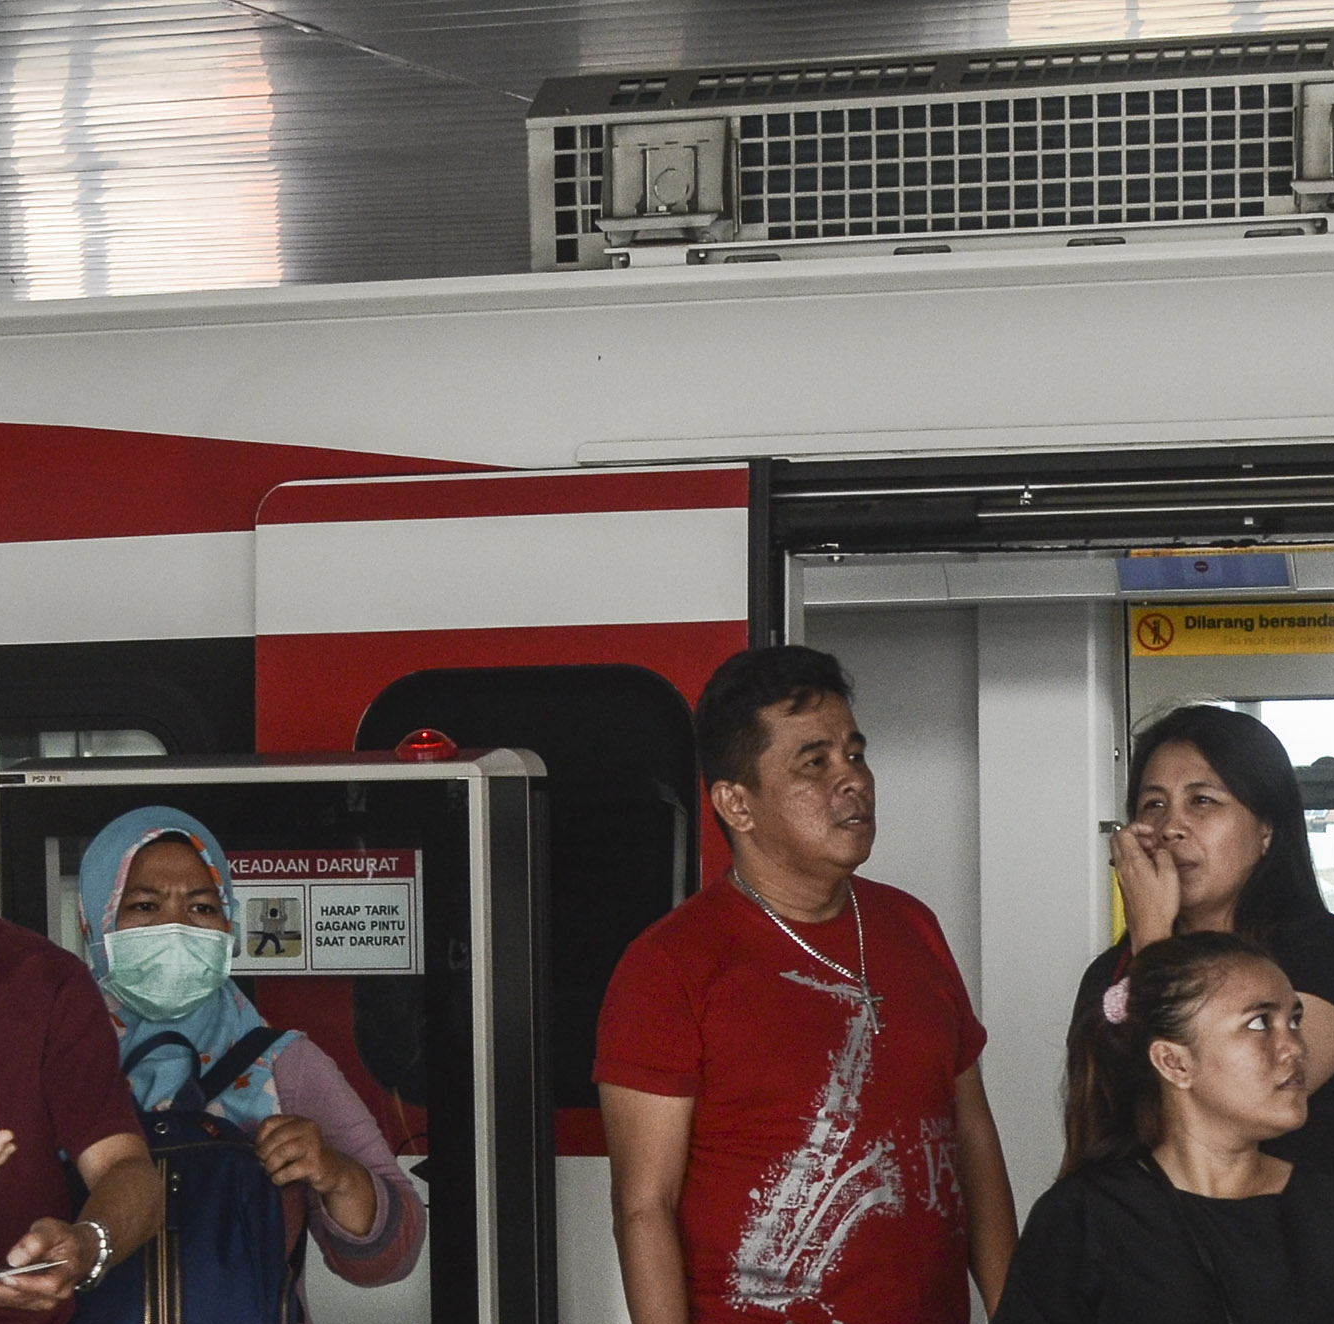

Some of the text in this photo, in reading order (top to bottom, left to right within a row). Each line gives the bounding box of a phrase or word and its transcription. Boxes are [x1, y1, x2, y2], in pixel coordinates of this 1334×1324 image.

[1185, 615, 1254, 631] Dilarang
[228, 857, 399, 874] KEADAAN DARURAT
[320, 905, 399, 916] HARAP TARIK
[315, 920, 405, 931] GAGANG PINTU
[315, 935, 406, 947] SAAT DARURAT
